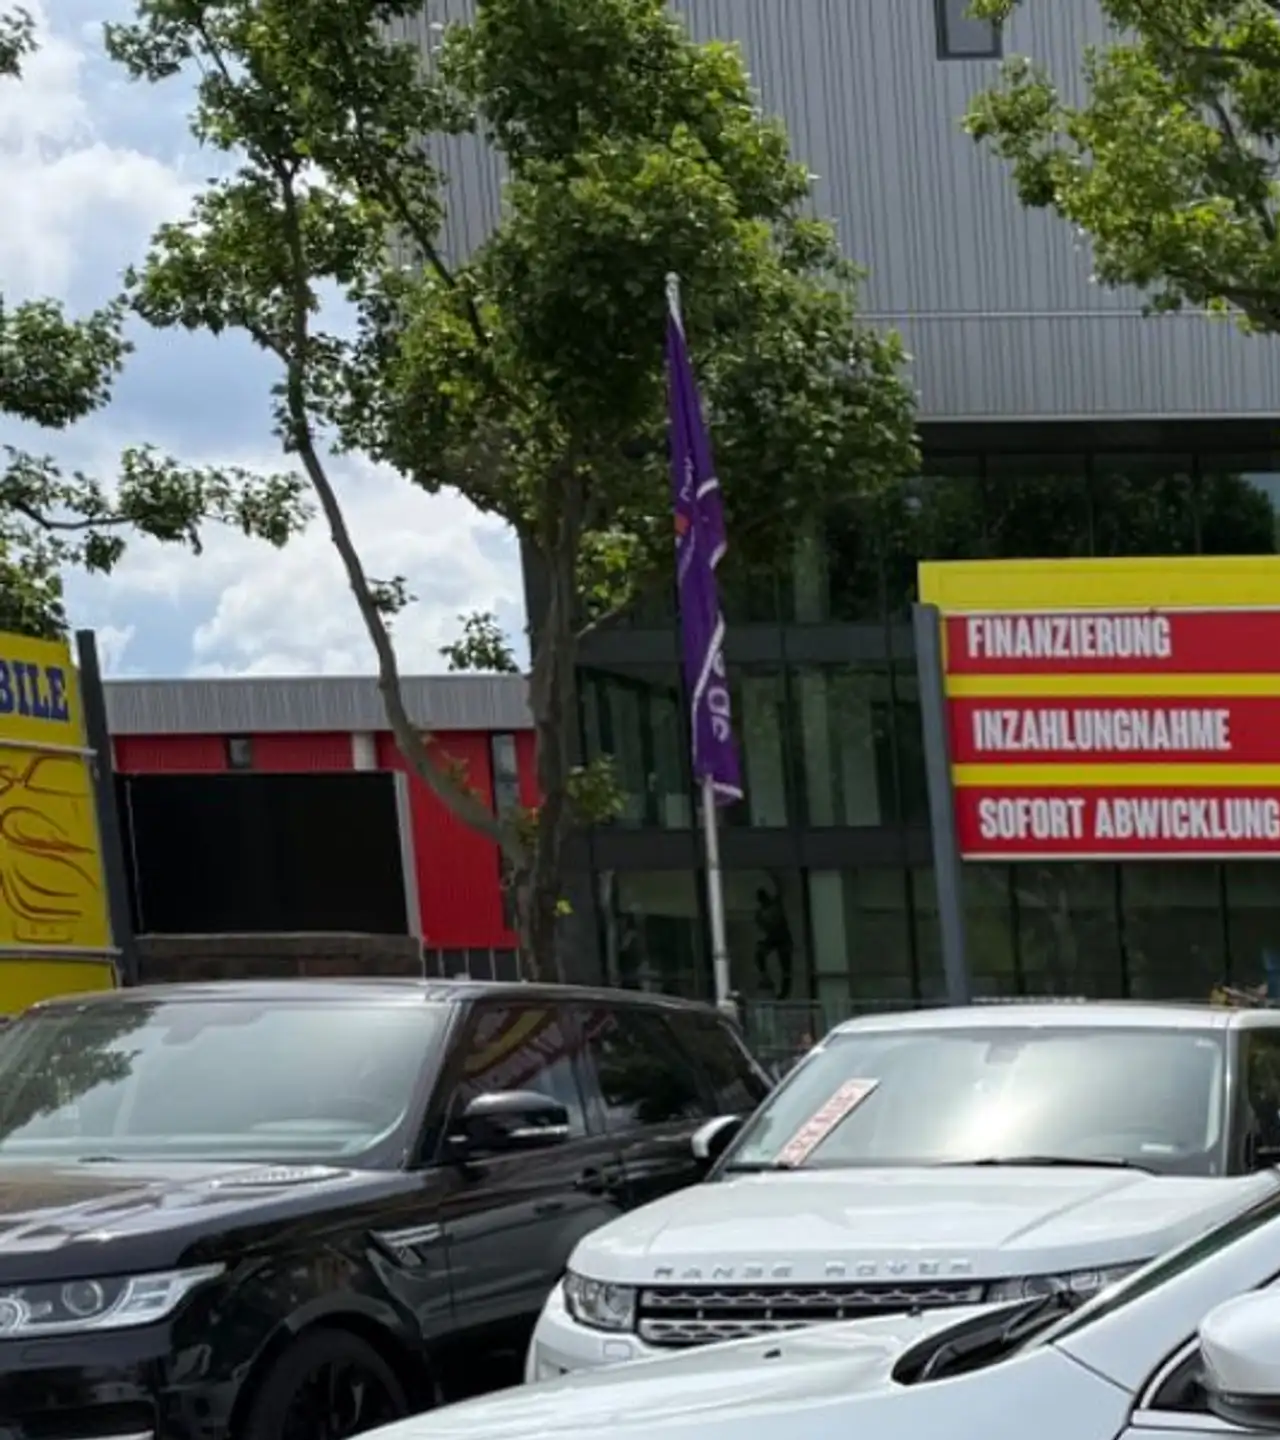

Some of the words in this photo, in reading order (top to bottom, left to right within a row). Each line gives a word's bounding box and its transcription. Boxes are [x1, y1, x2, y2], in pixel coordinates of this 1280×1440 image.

[967, 616, 1172, 658] FINANZIERUNG
[972, 709, 1232, 752] INZAHLUNGNAHME
[978, 797, 1085, 839] SOFORT
[653, 1261, 793, 1279] RANGE
[825, 1257, 974, 1278] ROVER
